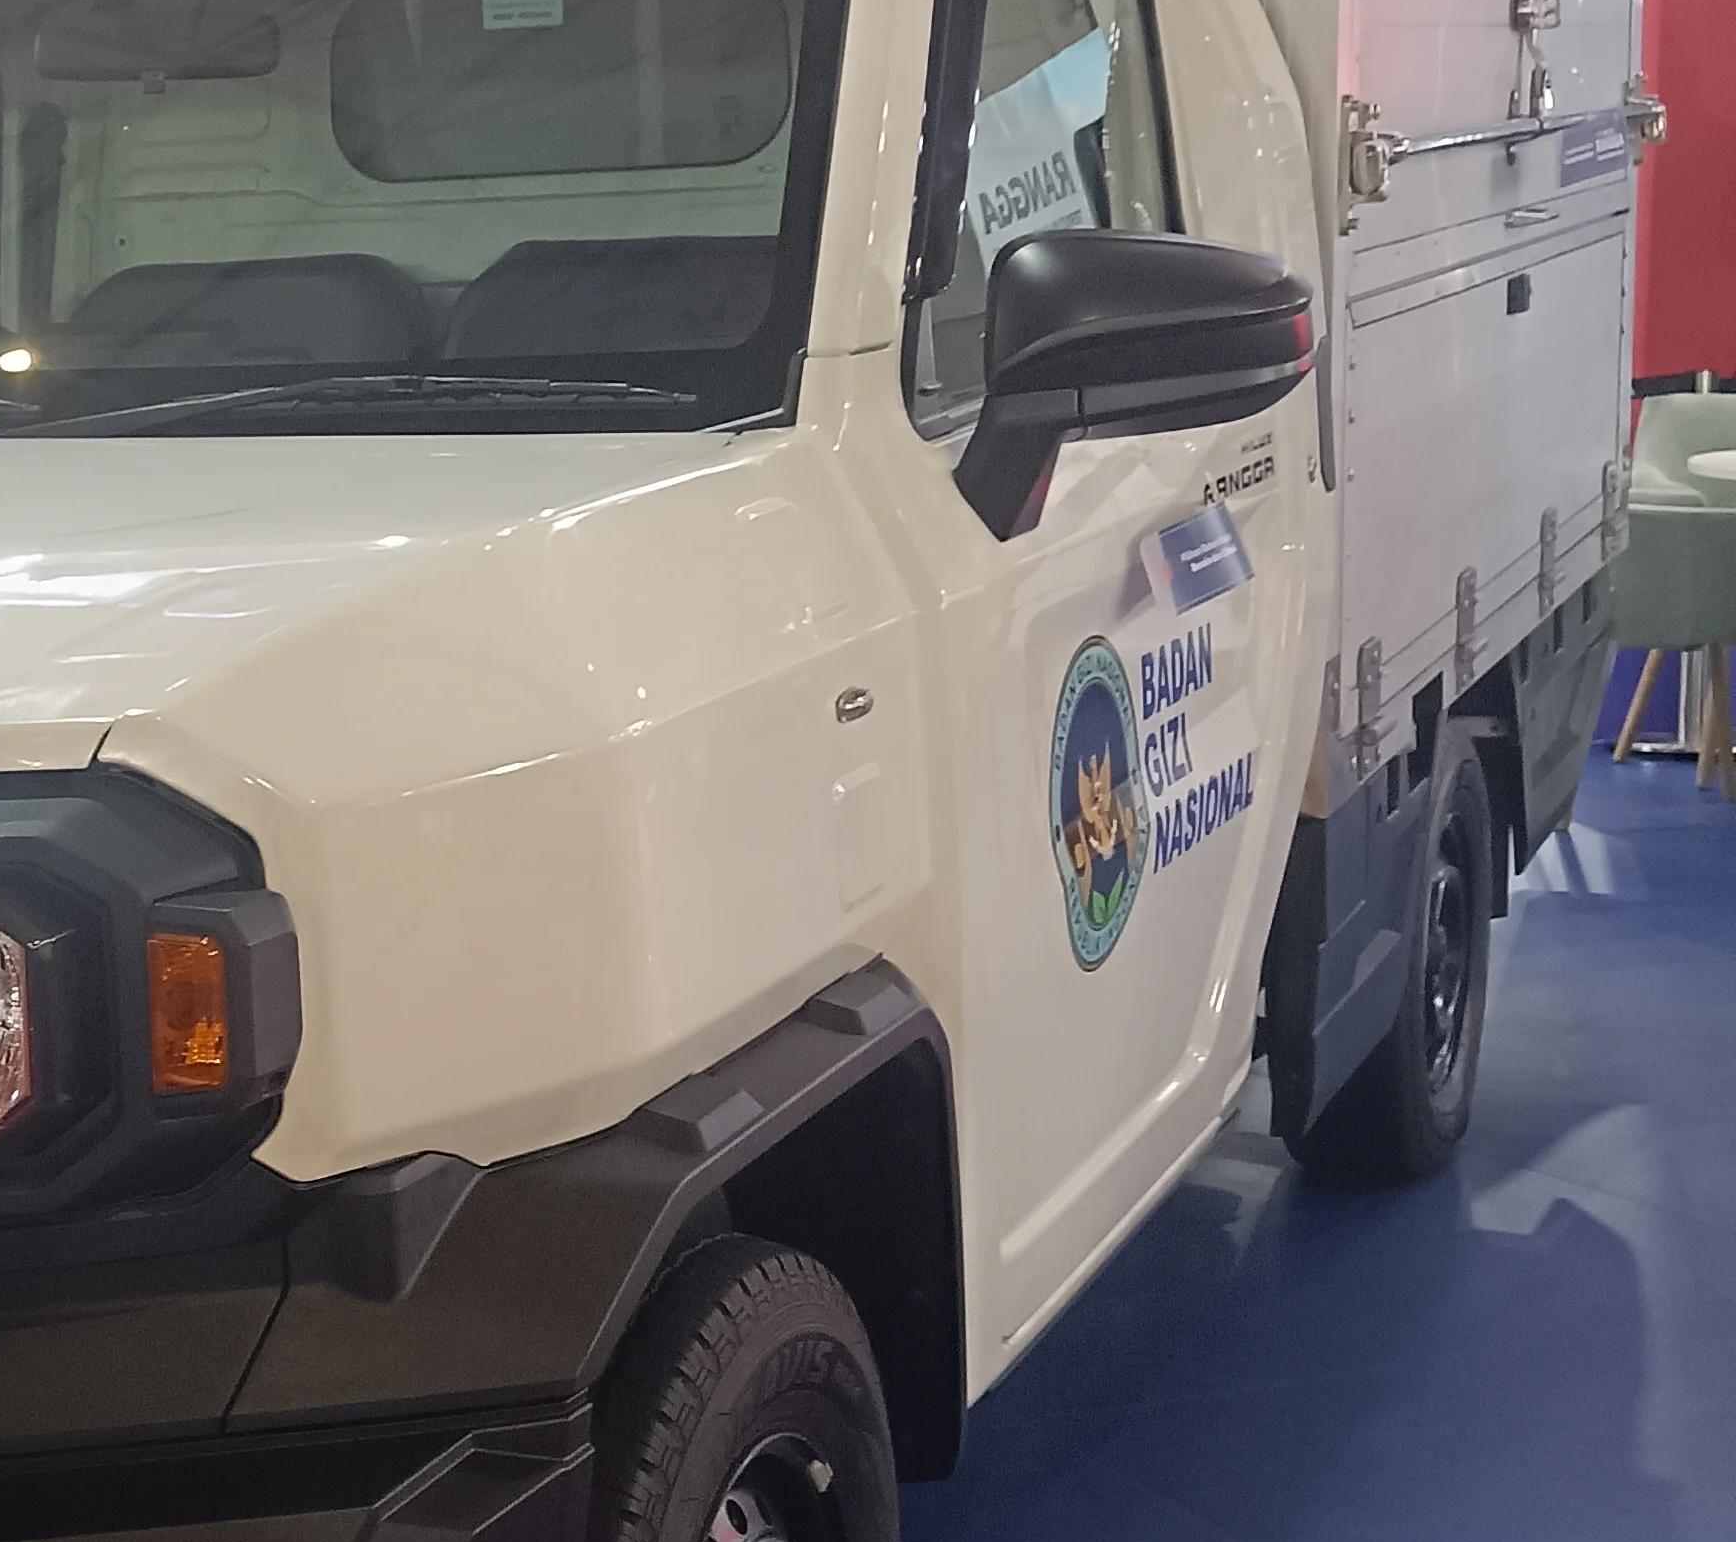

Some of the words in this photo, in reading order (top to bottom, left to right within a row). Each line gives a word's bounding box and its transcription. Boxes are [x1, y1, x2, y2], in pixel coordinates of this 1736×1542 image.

[1141, 622, 1212, 721] BADAN
[1144, 713, 1194, 798] GIZI
[1153, 752, 1254, 875] NASIONAL
